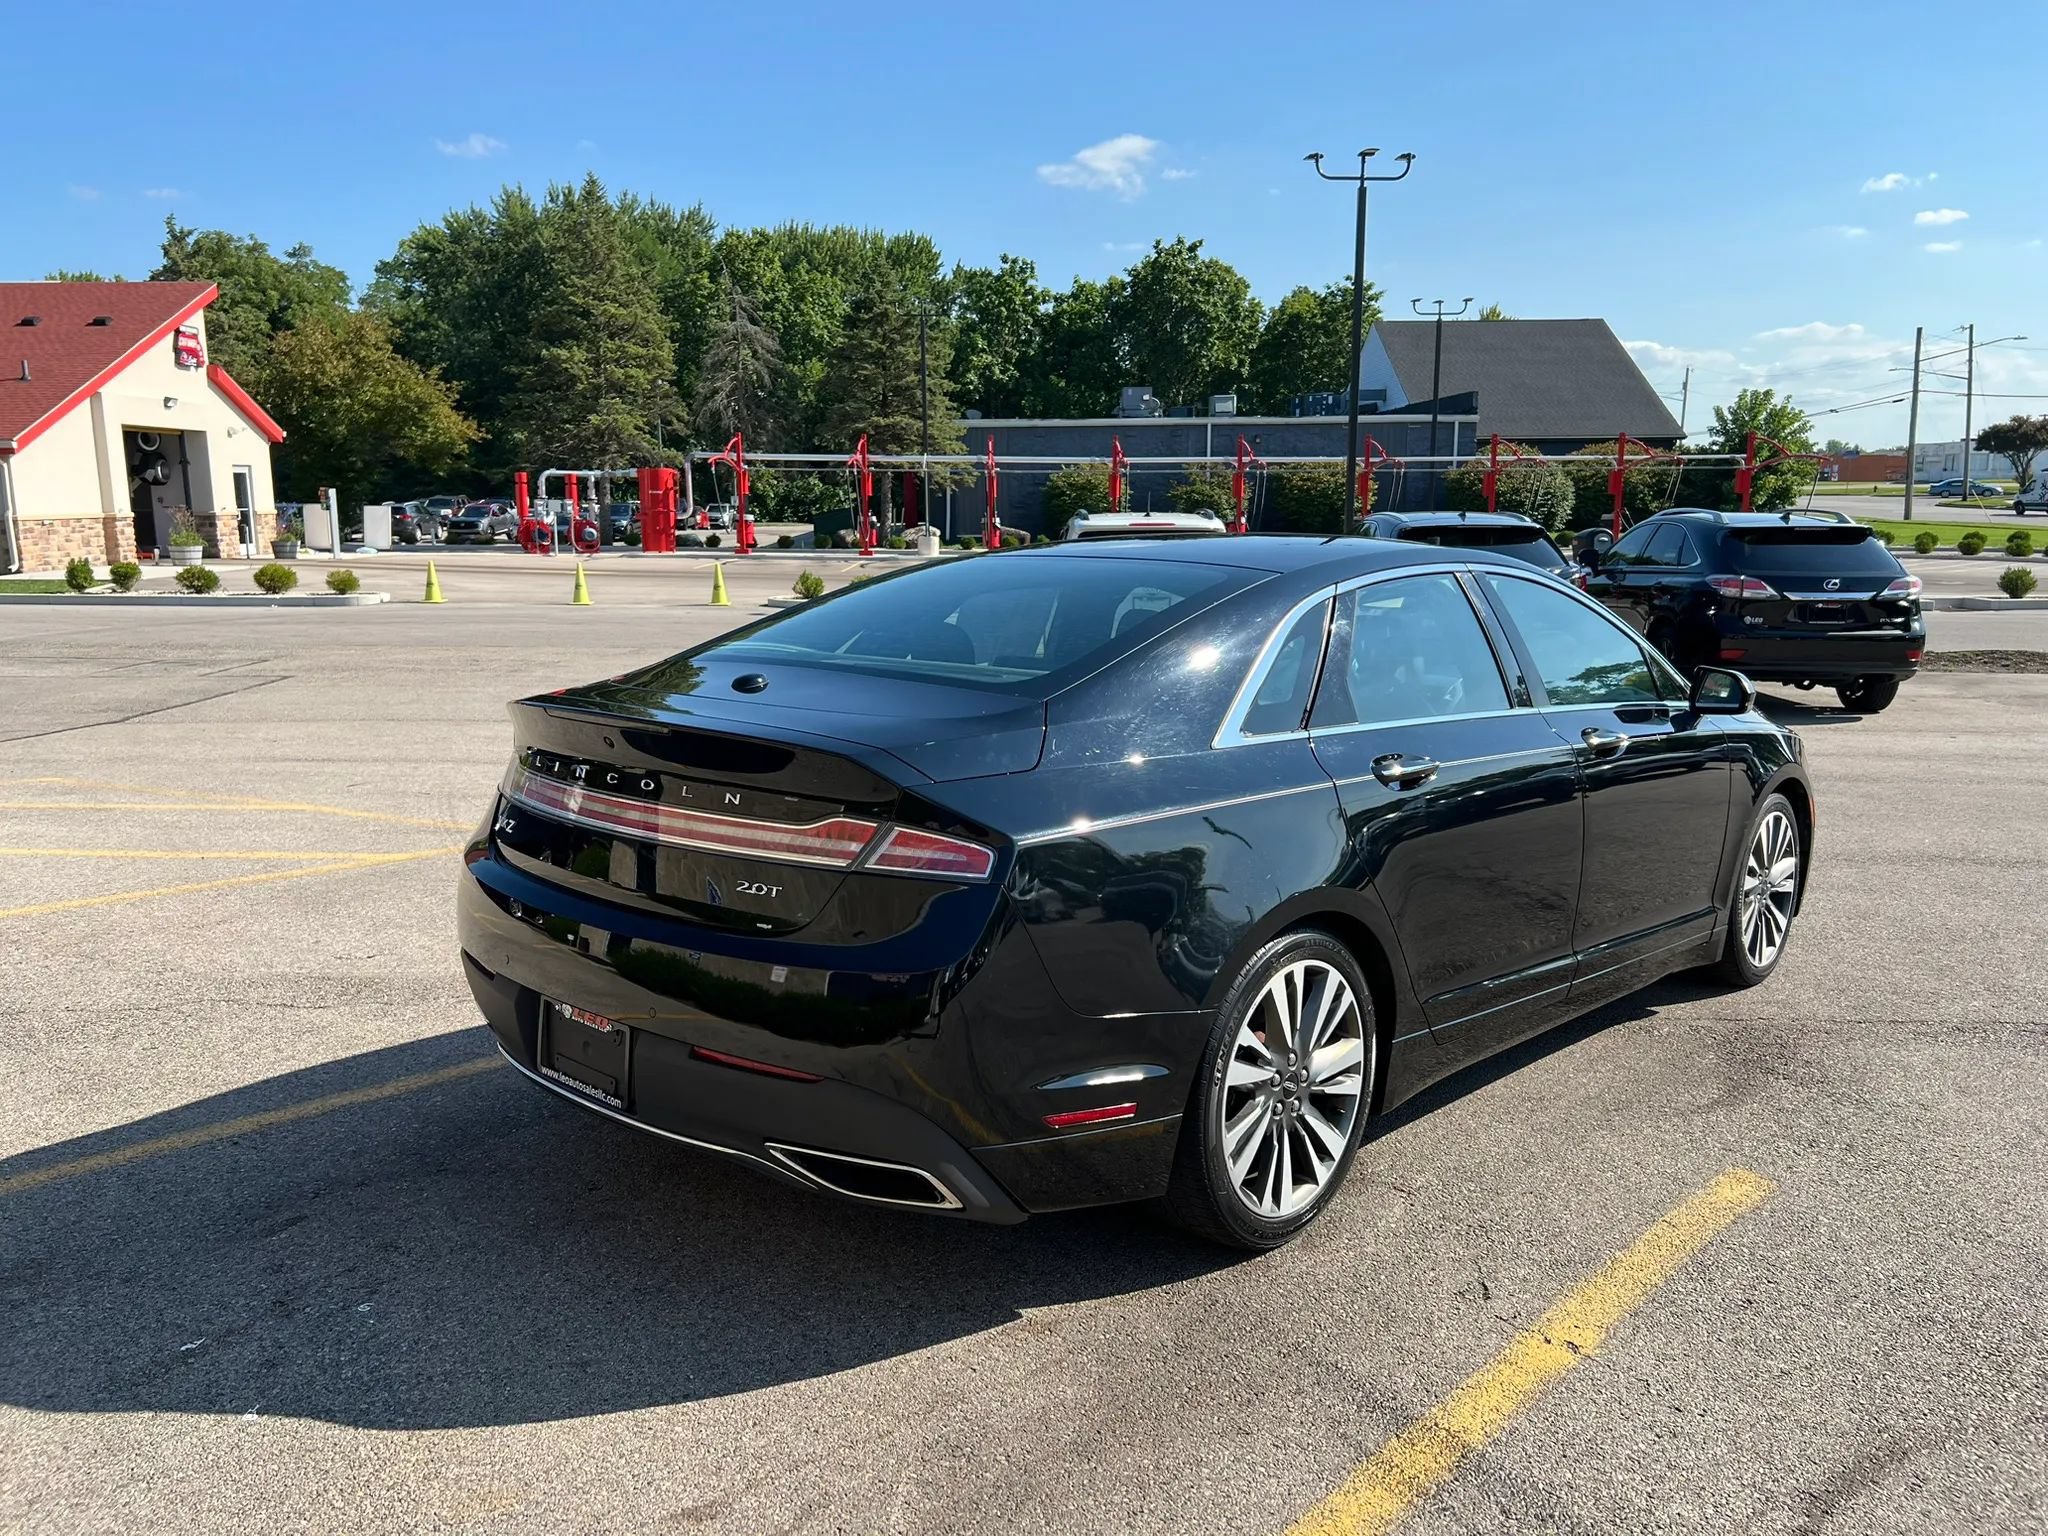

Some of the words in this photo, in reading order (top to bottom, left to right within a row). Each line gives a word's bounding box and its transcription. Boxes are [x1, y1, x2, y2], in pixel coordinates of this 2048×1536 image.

[535, 755, 741, 806] LINCOLN
[572, 1006, 610, 1030] LEO
[541, 1066, 622, 1109] www.leoautosalesllc.com
